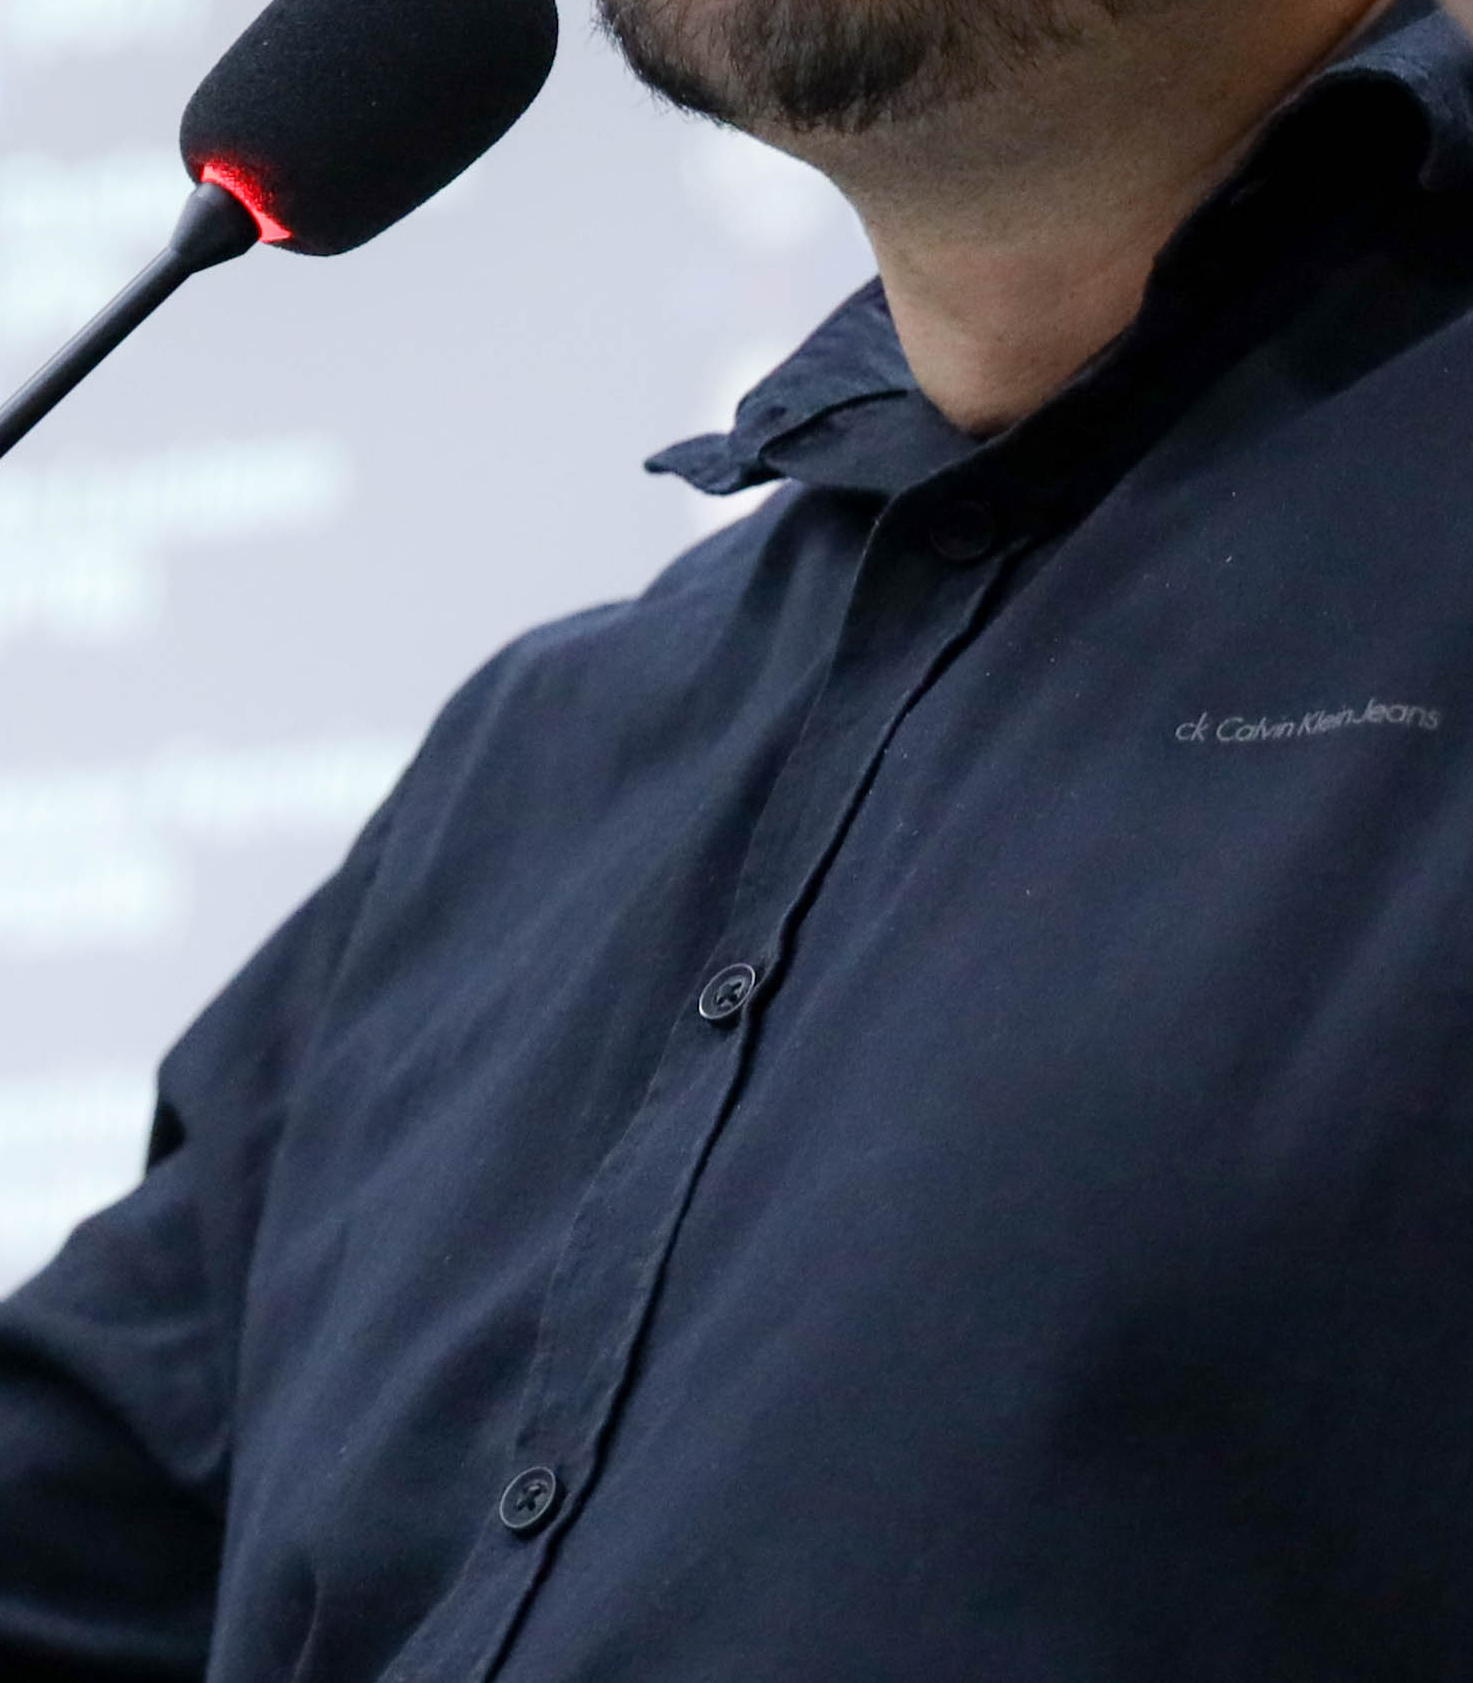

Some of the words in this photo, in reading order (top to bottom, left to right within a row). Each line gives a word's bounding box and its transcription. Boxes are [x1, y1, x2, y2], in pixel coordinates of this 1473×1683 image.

[1174, 712, 1209, 742] ck
[1215, 716, 1294, 743] Calvin
[1352, 697, 1440, 731] Jeans
